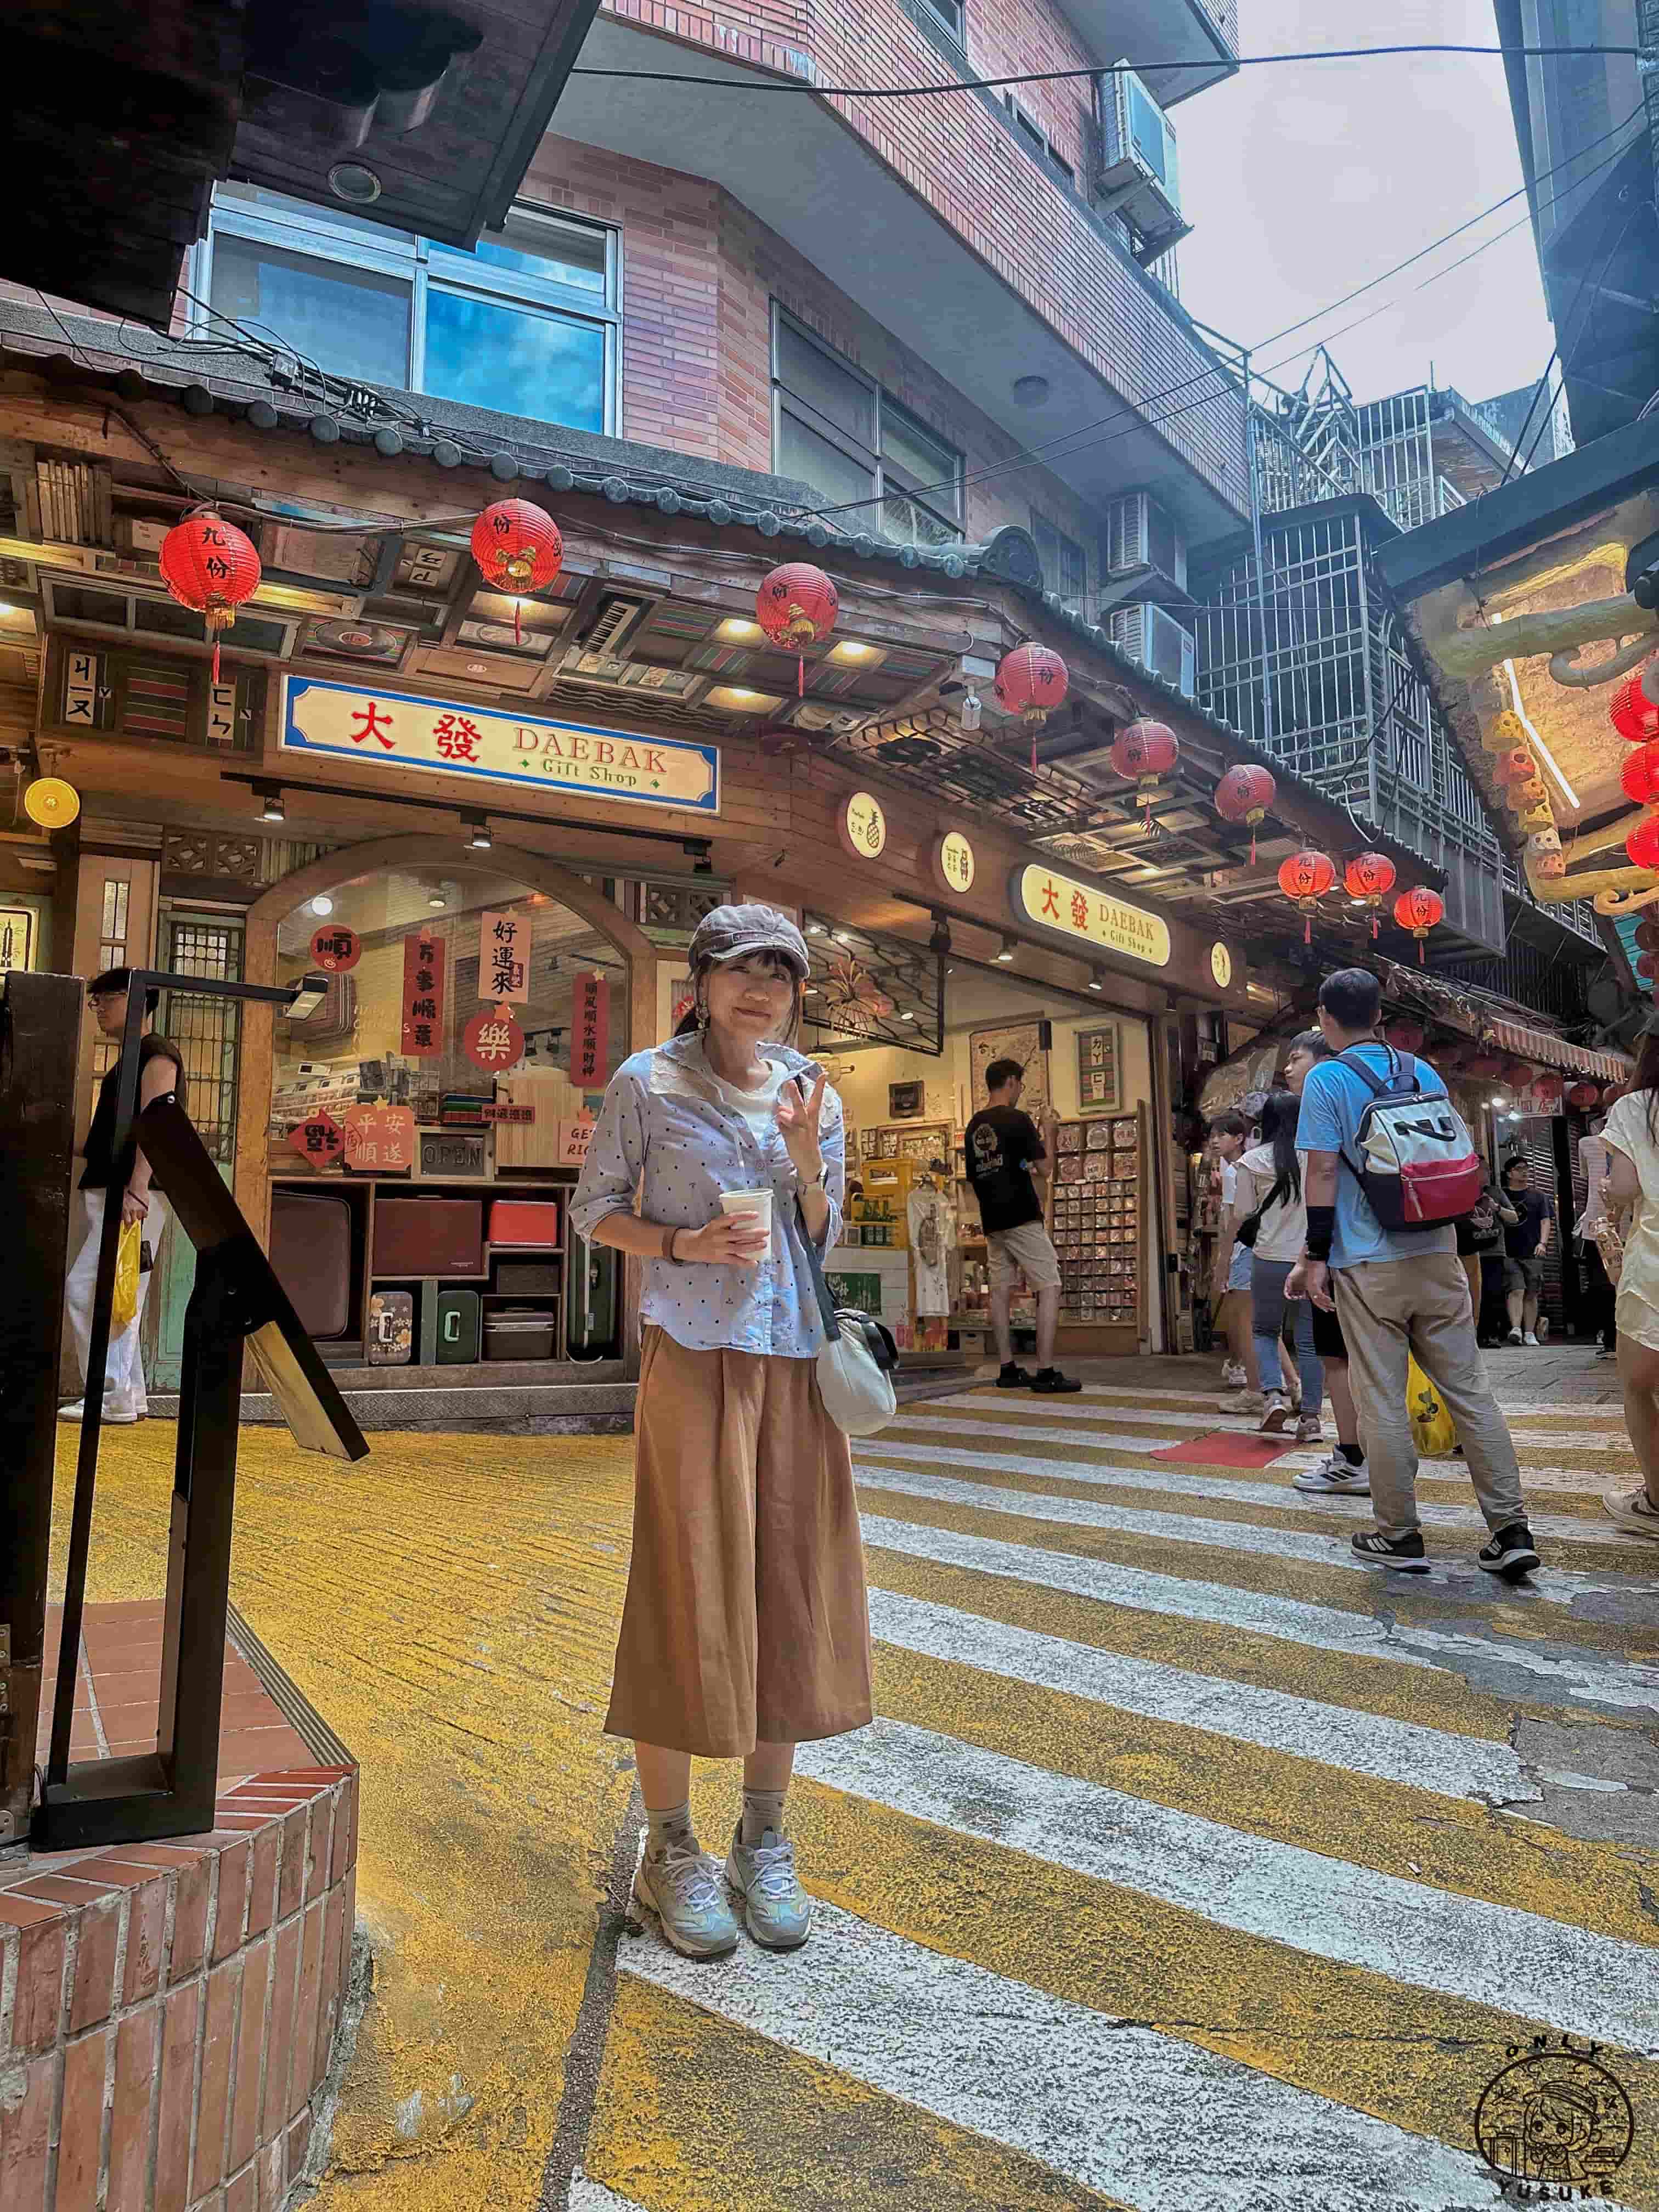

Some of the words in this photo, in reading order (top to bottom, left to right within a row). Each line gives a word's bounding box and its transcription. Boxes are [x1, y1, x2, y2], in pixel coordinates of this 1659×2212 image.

[202, 526, 230, 579] 九份
[351, 702, 483, 763] 大發
[513, 727, 667, 774] DAEBAK
[541, 758, 580, 777] Gift
[589, 766, 637, 787] Shop
[1042, 878, 1089, 930] 大發
[1099, 904, 1154, 940] DAEBAK
[492, 921, 518, 995] 好運來
[1110, 930, 1125, 944] Gift
[1127, 936, 1146, 953] Shop
[476, 1023, 511, 1060] 樂
[357, 1113, 406, 1136] 平安
[422, 1143, 483, 1167] OPEN
